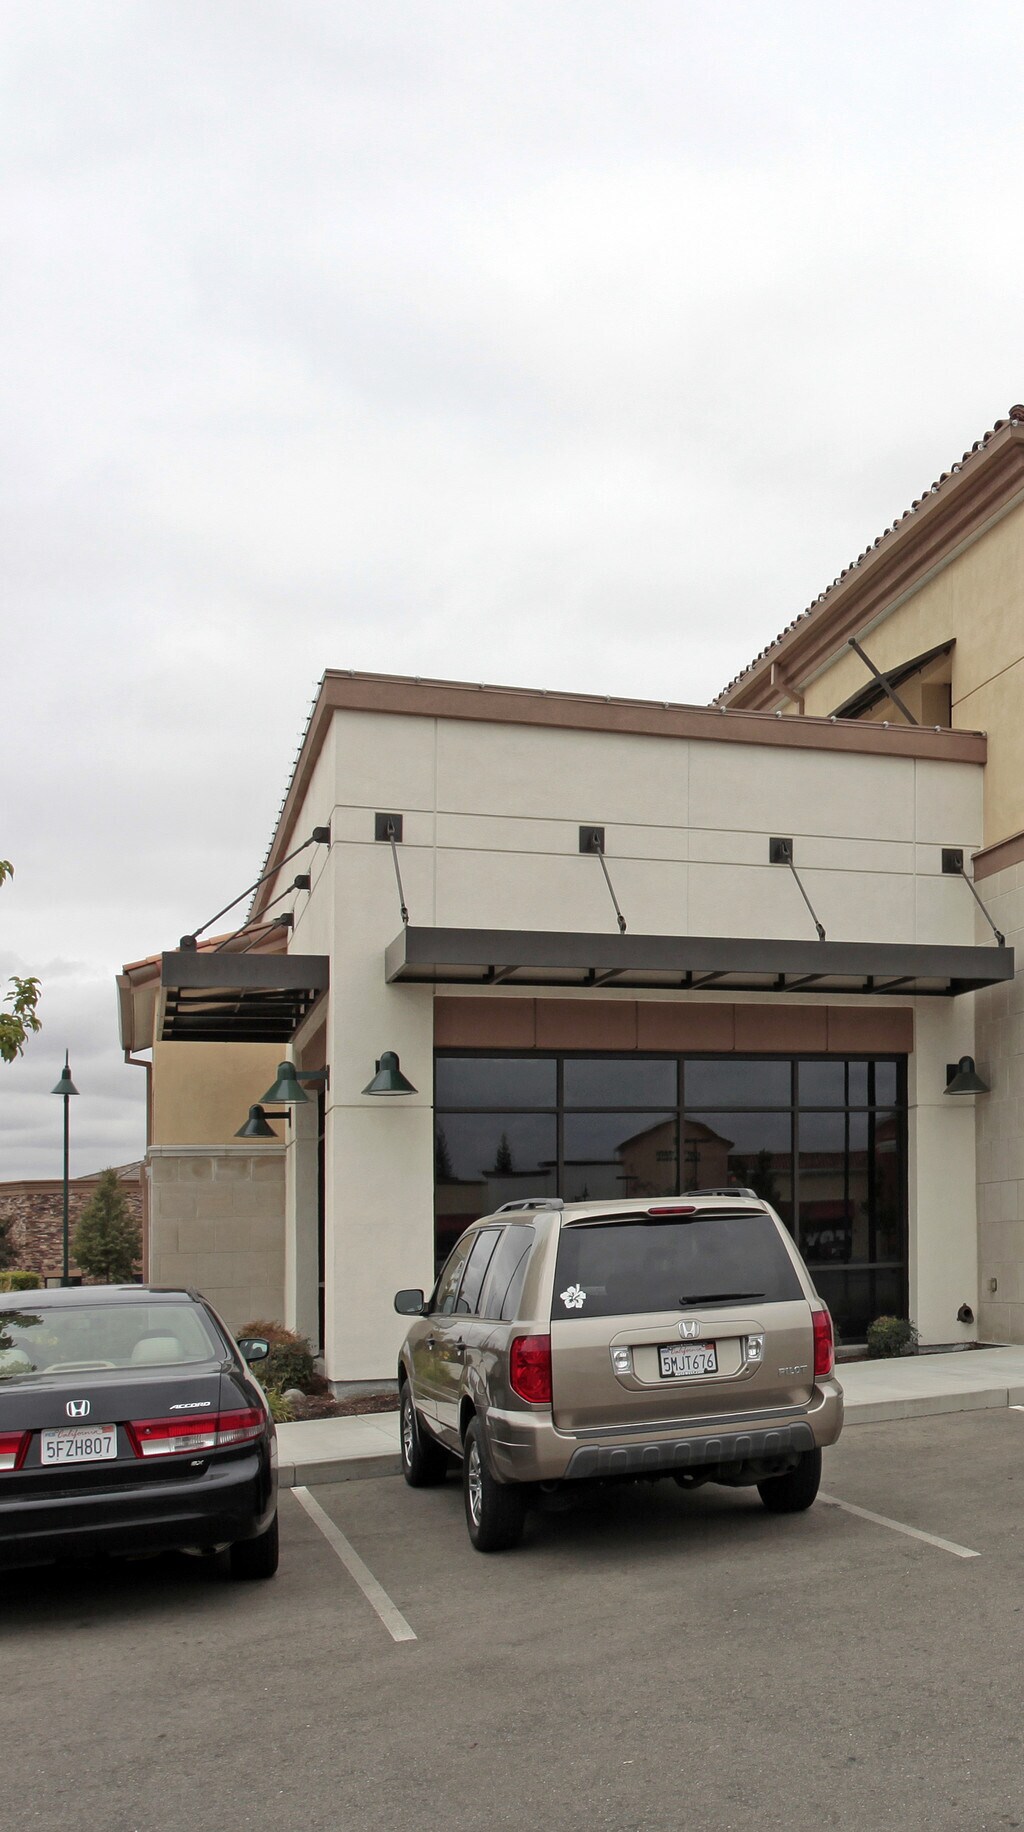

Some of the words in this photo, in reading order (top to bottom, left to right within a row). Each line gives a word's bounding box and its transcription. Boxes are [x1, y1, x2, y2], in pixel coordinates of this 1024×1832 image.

[663, 1353, 713, 1372] 5MJT676
[778, 1365, 808, 1377] PILOT
[169, 1401, 211, 1410] ACCORD
[57, 1428, 101, 1439] California
[46, 1436, 112, 1459] 5FZH807
